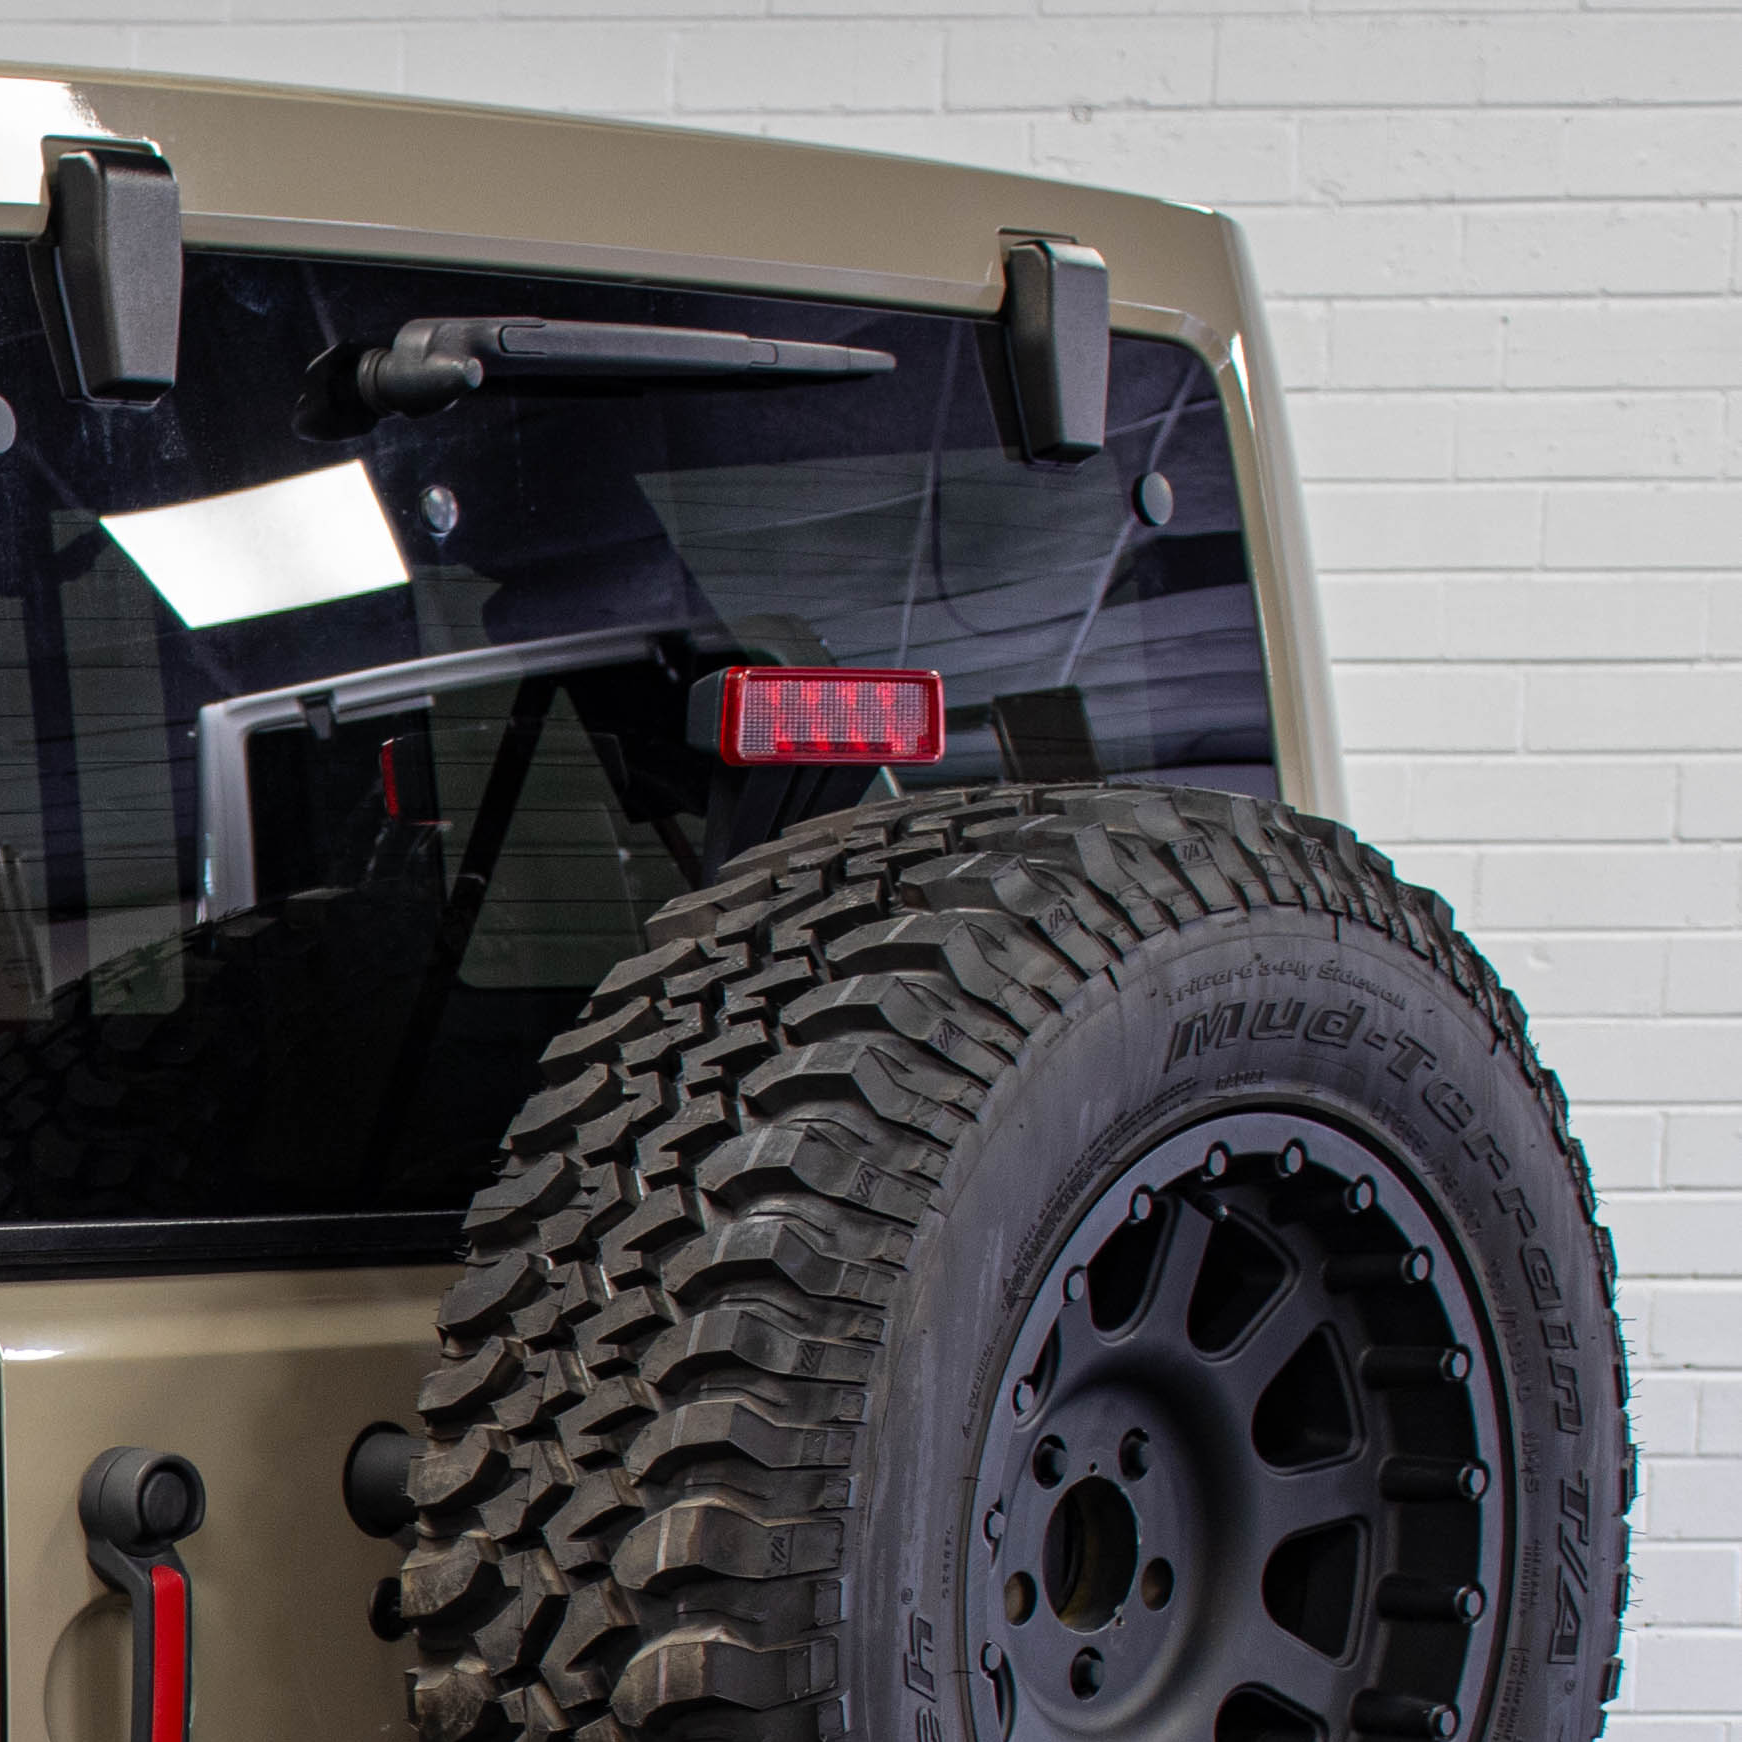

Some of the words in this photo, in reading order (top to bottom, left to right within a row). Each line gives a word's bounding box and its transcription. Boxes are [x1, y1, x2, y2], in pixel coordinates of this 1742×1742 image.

[1316, 956, 1407, 1017] Sidewall
[1214, 1067, 1267, 1091] RADIAL
[1165, 996, 1581, 1438] Mud-Terrain
[1547, 1468, 1591, 1672] T/A
